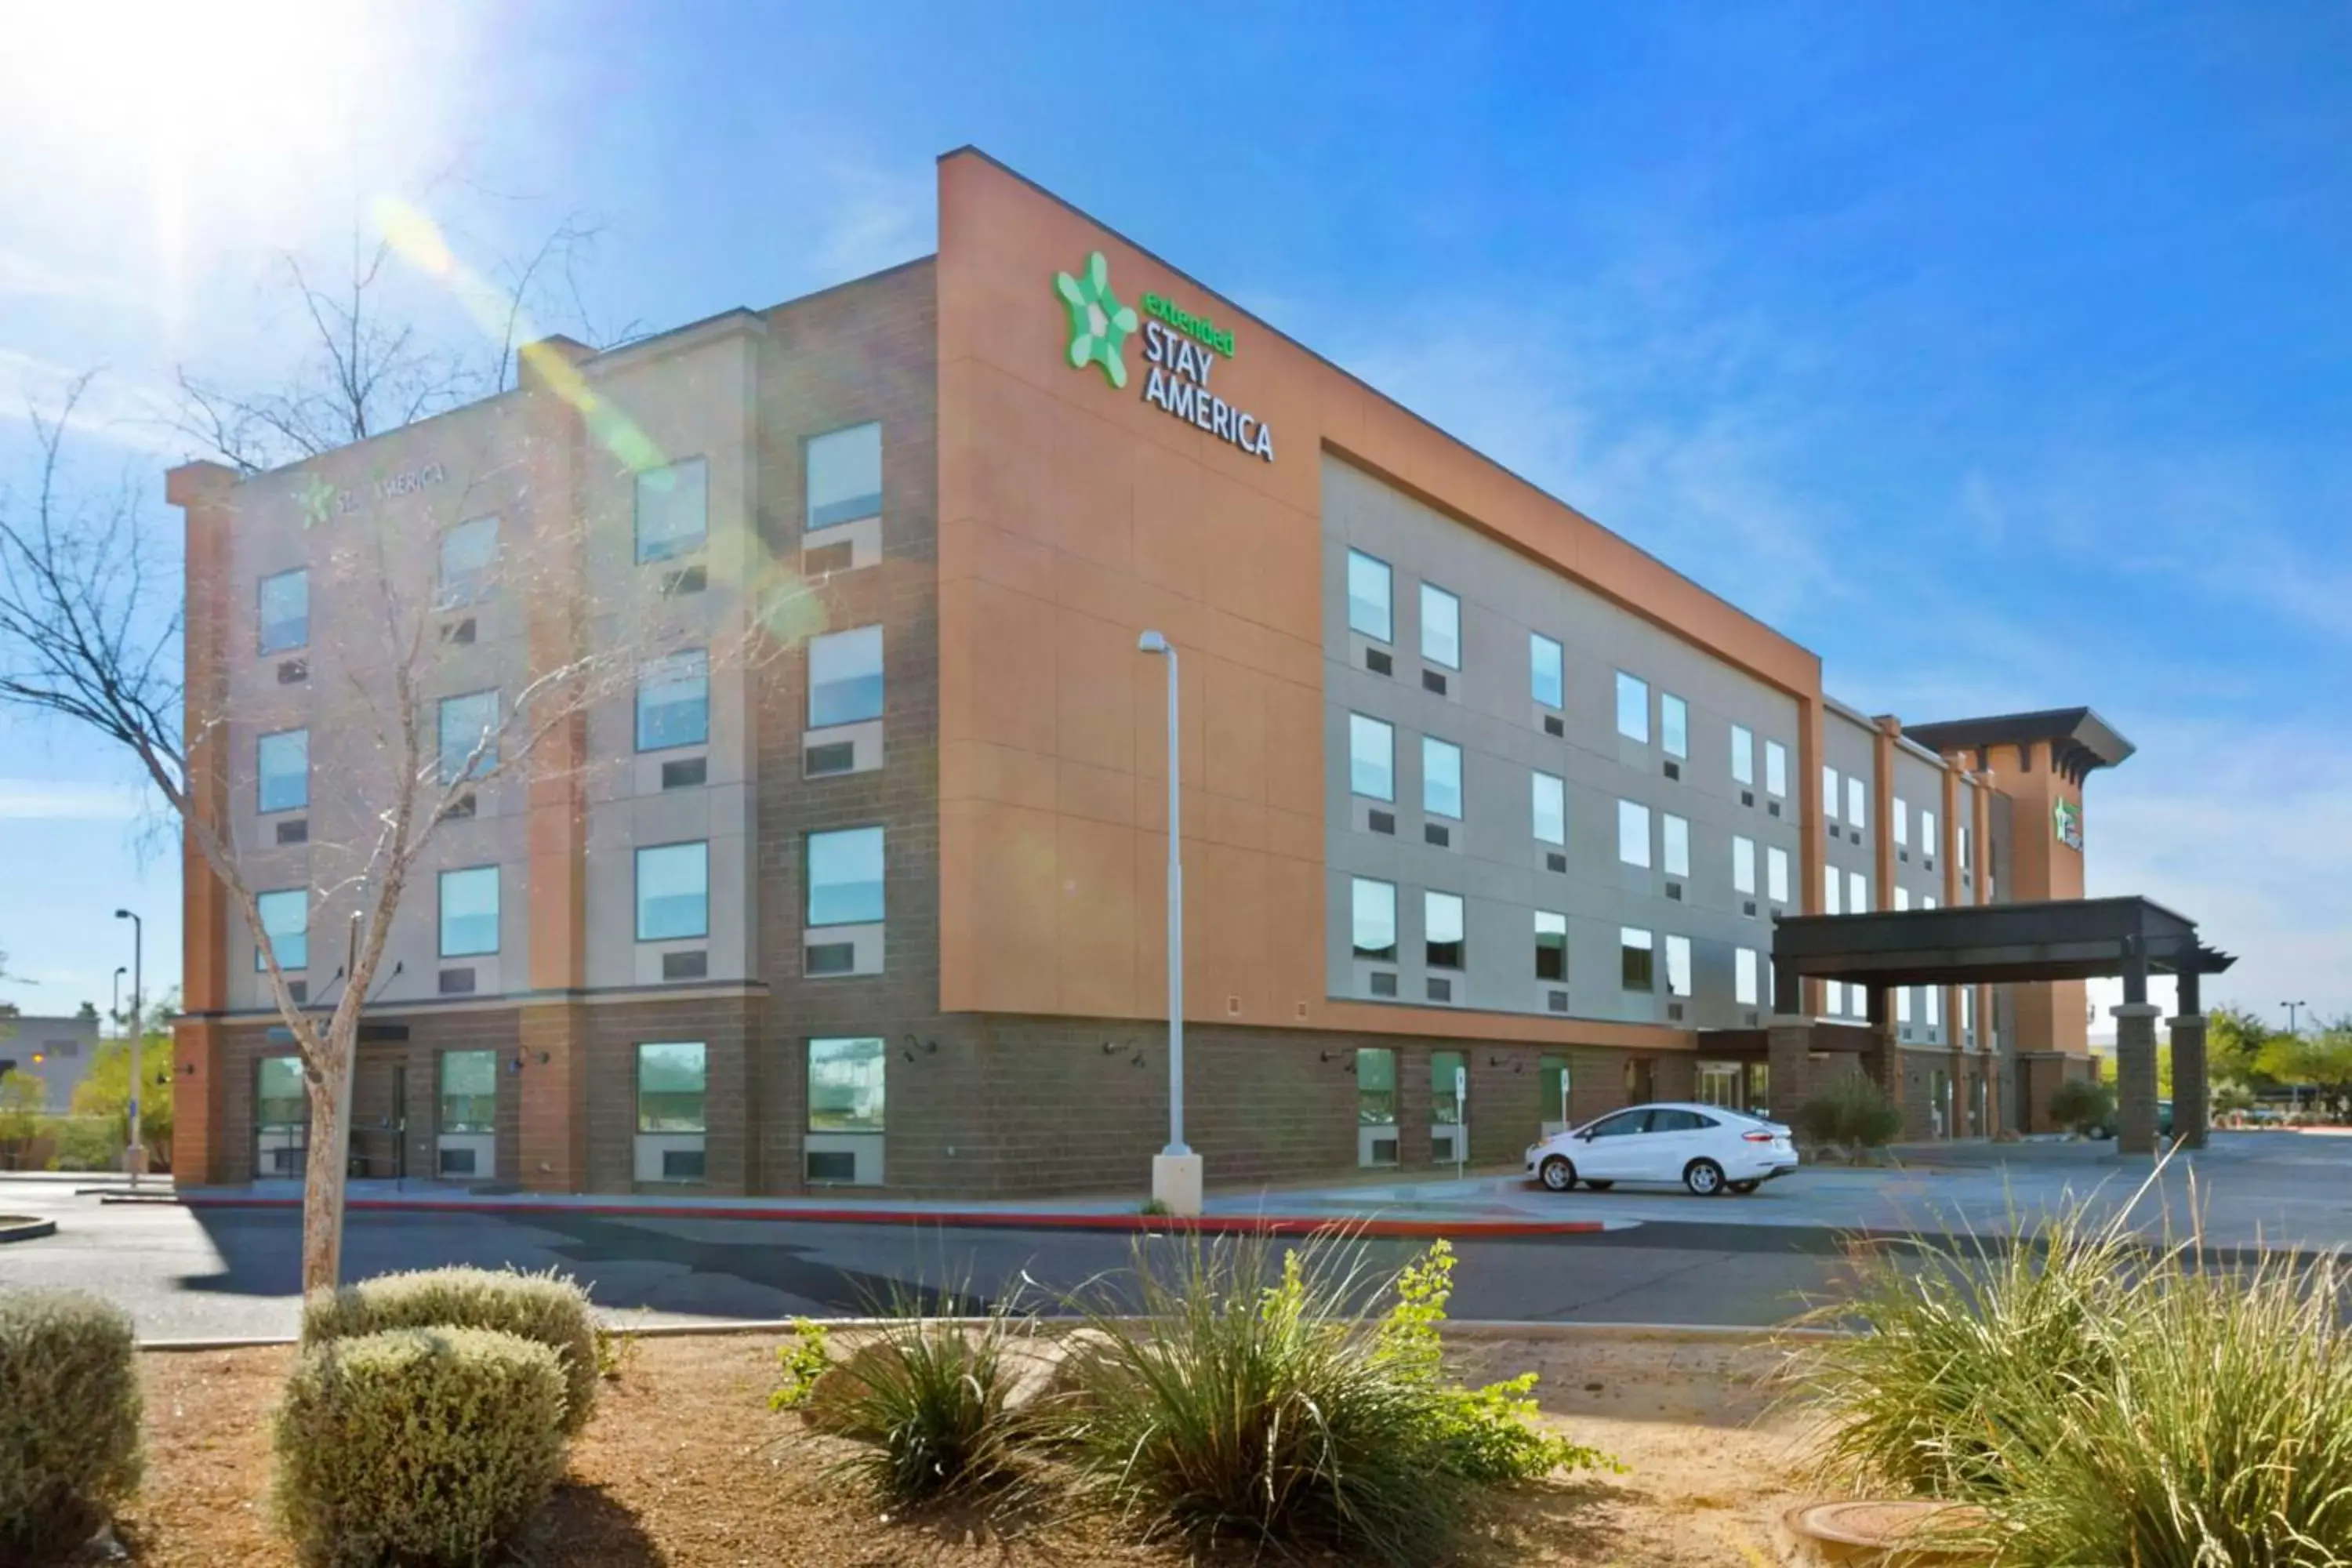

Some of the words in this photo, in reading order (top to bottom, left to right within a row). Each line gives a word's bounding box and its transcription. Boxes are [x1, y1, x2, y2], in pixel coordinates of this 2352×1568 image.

[1142, 292, 1236, 358] extended
[1144, 320, 1214, 387] STAY
[1144, 366, 1274, 462] AMERICA
